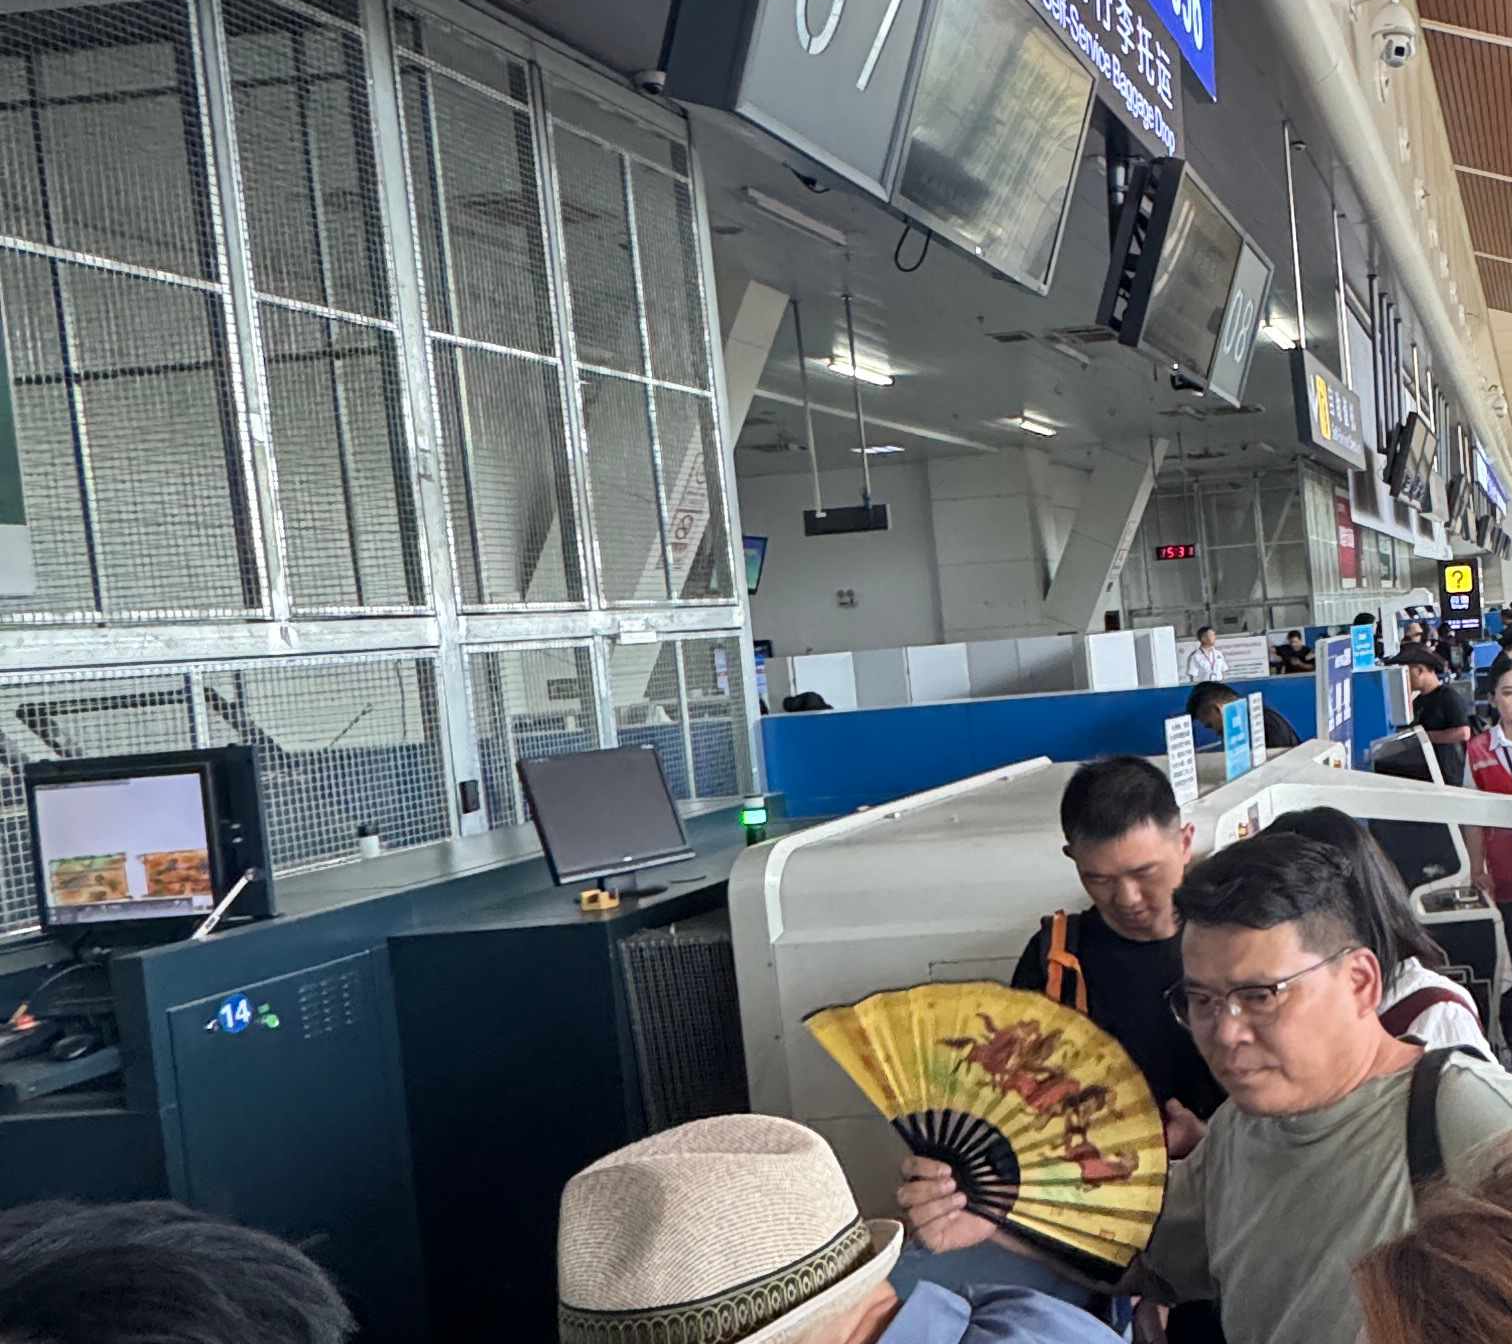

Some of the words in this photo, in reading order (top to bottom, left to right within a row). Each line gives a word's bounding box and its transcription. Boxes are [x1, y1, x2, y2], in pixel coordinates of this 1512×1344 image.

[1111, 53, 1156, 131] Baggage
[1154, 105, 1176, 157] Drop
[1223, 288, 1254, 364] 08
[220, 998, 251, 1028] 14
